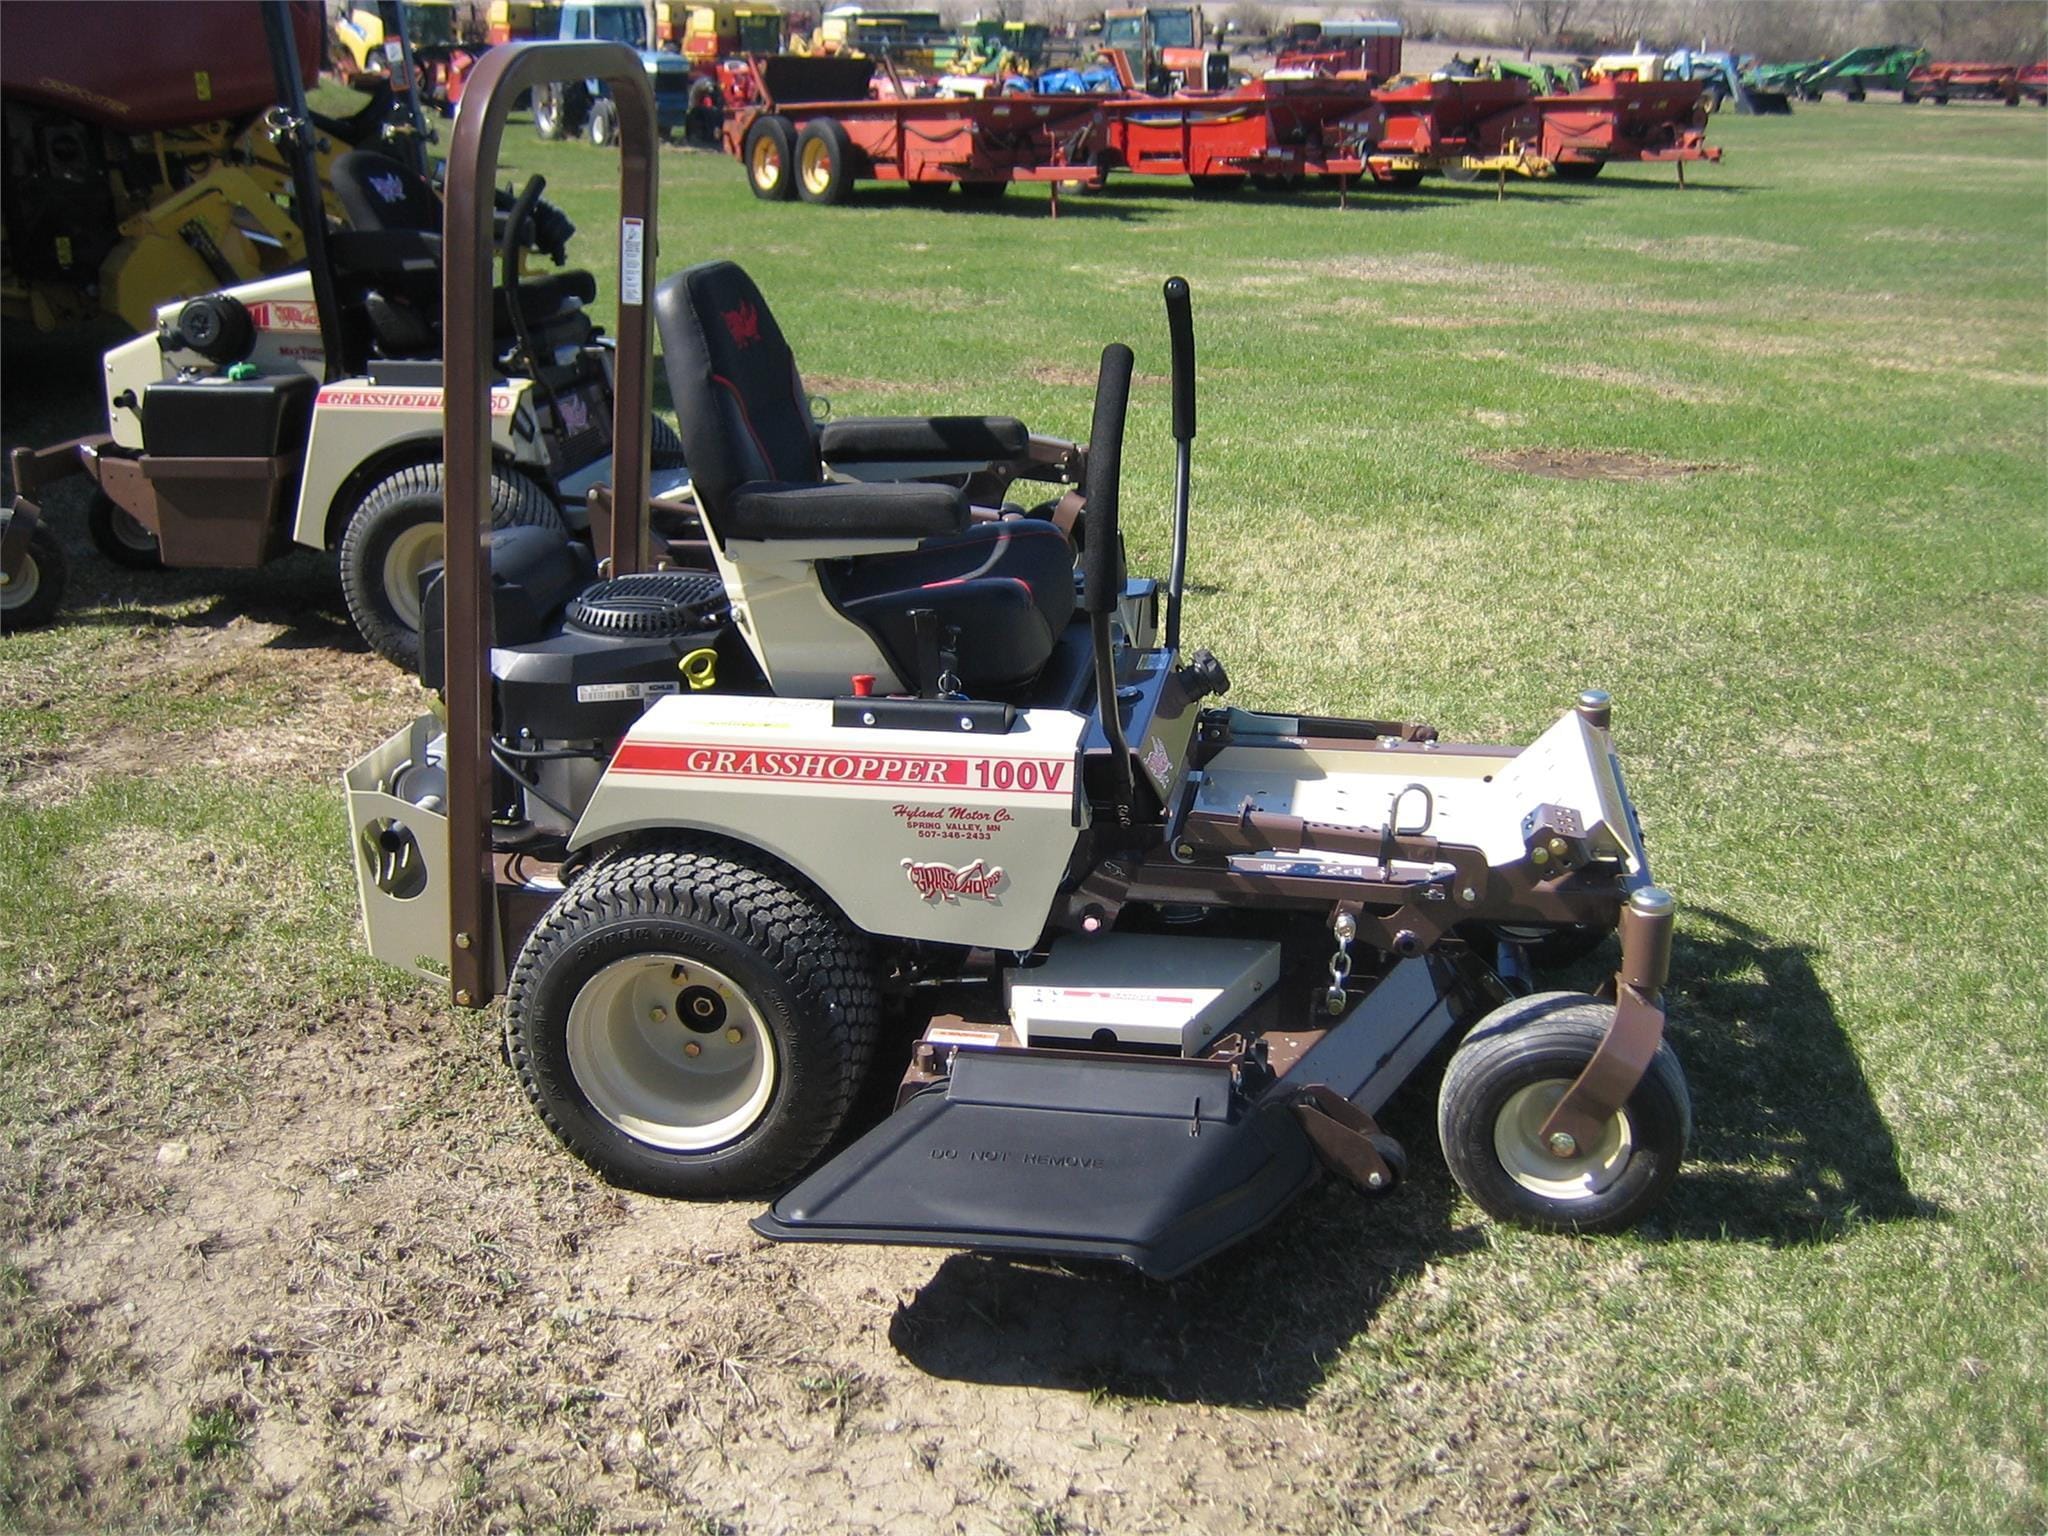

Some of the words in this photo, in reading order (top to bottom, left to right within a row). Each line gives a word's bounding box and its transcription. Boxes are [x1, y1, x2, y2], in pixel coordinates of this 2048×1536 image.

[687, 750, 947, 782] GRASSHOPPER
[975, 760, 1065, 790] 100V
[892, 804, 945, 820] Hyland
[948, 806, 991, 820] Motor
[993, 808, 1015, 822] Co.
[946, 823, 982, 832] VALLEY,
[930, 1148, 959, 1160] DO
[970, 1151, 1011, 1162] NOT
[1024, 1153, 1104, 1169] REMOVE
